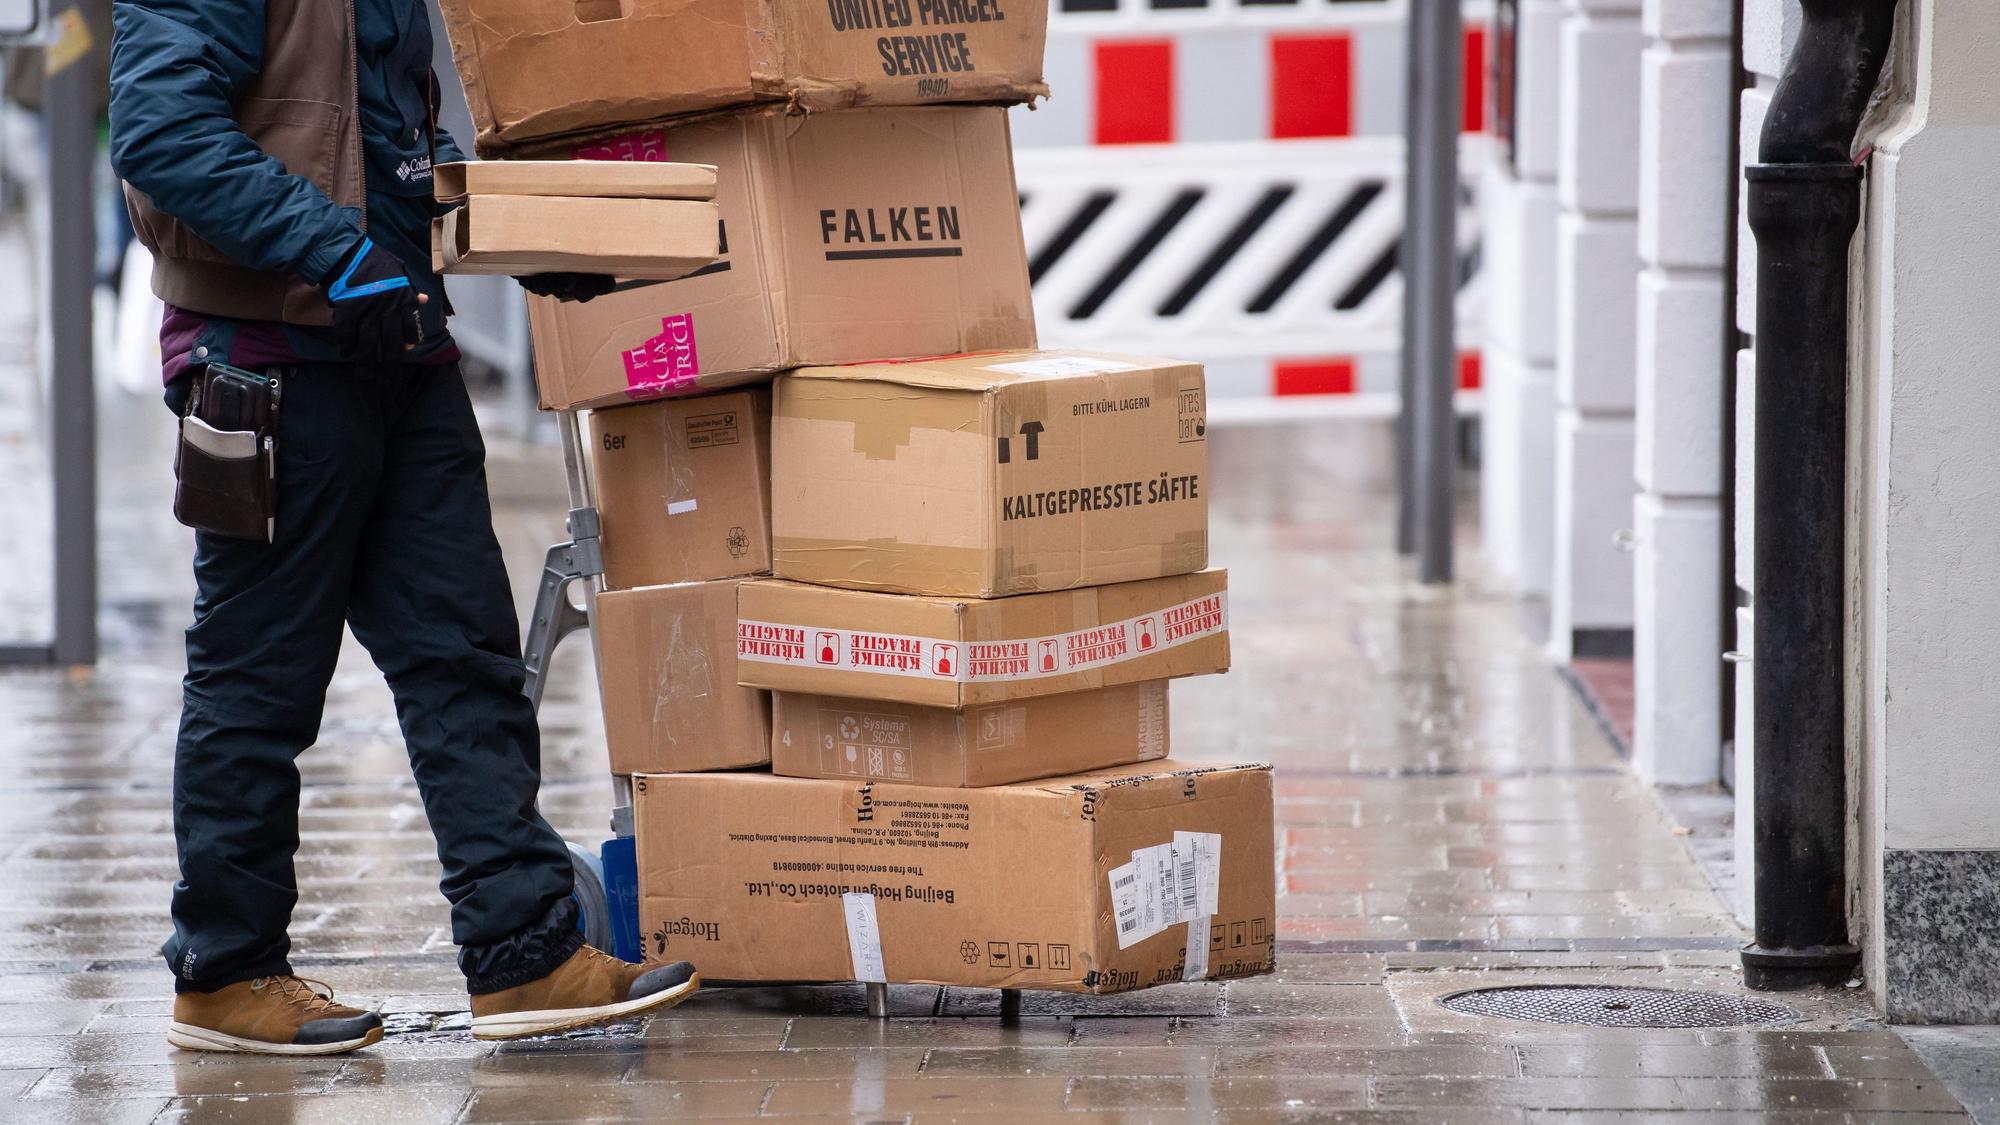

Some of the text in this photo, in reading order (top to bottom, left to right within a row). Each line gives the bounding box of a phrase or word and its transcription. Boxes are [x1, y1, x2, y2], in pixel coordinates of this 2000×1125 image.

[877, 32, 975, 77] SERVICE
[820, 206, 960, 244] FALKEN
[1072, 397, 1150, 416] BITTE KÜHL LAGERN
[603, 433, 626, 450] 6er
[1003, 472, 1198, 521] KALTGEPRESSTE SÄFTE
[1164, 596, 1221, 625] FRAGILE
[739, 623, 805, 643] FRAGILE
[1067, 624, 1126, 650] FRAGILE
[850, 634, 921, 654] FRAGILE
[969, 642, 1028, 658] FRAGILE
[782, 730, 791, 747] 4
[825, 734, 833, 750] 3
[940, 803, 969, 811] Website:
[922, 820, 931, 828] 10
[941, 812, 953, 820] +86
[932, 821, 944, 829] +86
[945, 822, 969, 830] Phone:
[755, 833, 778, 842] Daxing
[797, 835, 833, 844] Biomedical
[826, 864, 855, 872] hotline
[856, 864, 888, 874] service
[889, 866, 907, 875] free
[907, 867, 924, 876] The
[744, 882, 797, 897] Co.,Ltd.
[852, 884, 902, 902] Hotgen
[905, 885, 955, 904] Beijing
[663, 917, 720, 941] Hotgen
